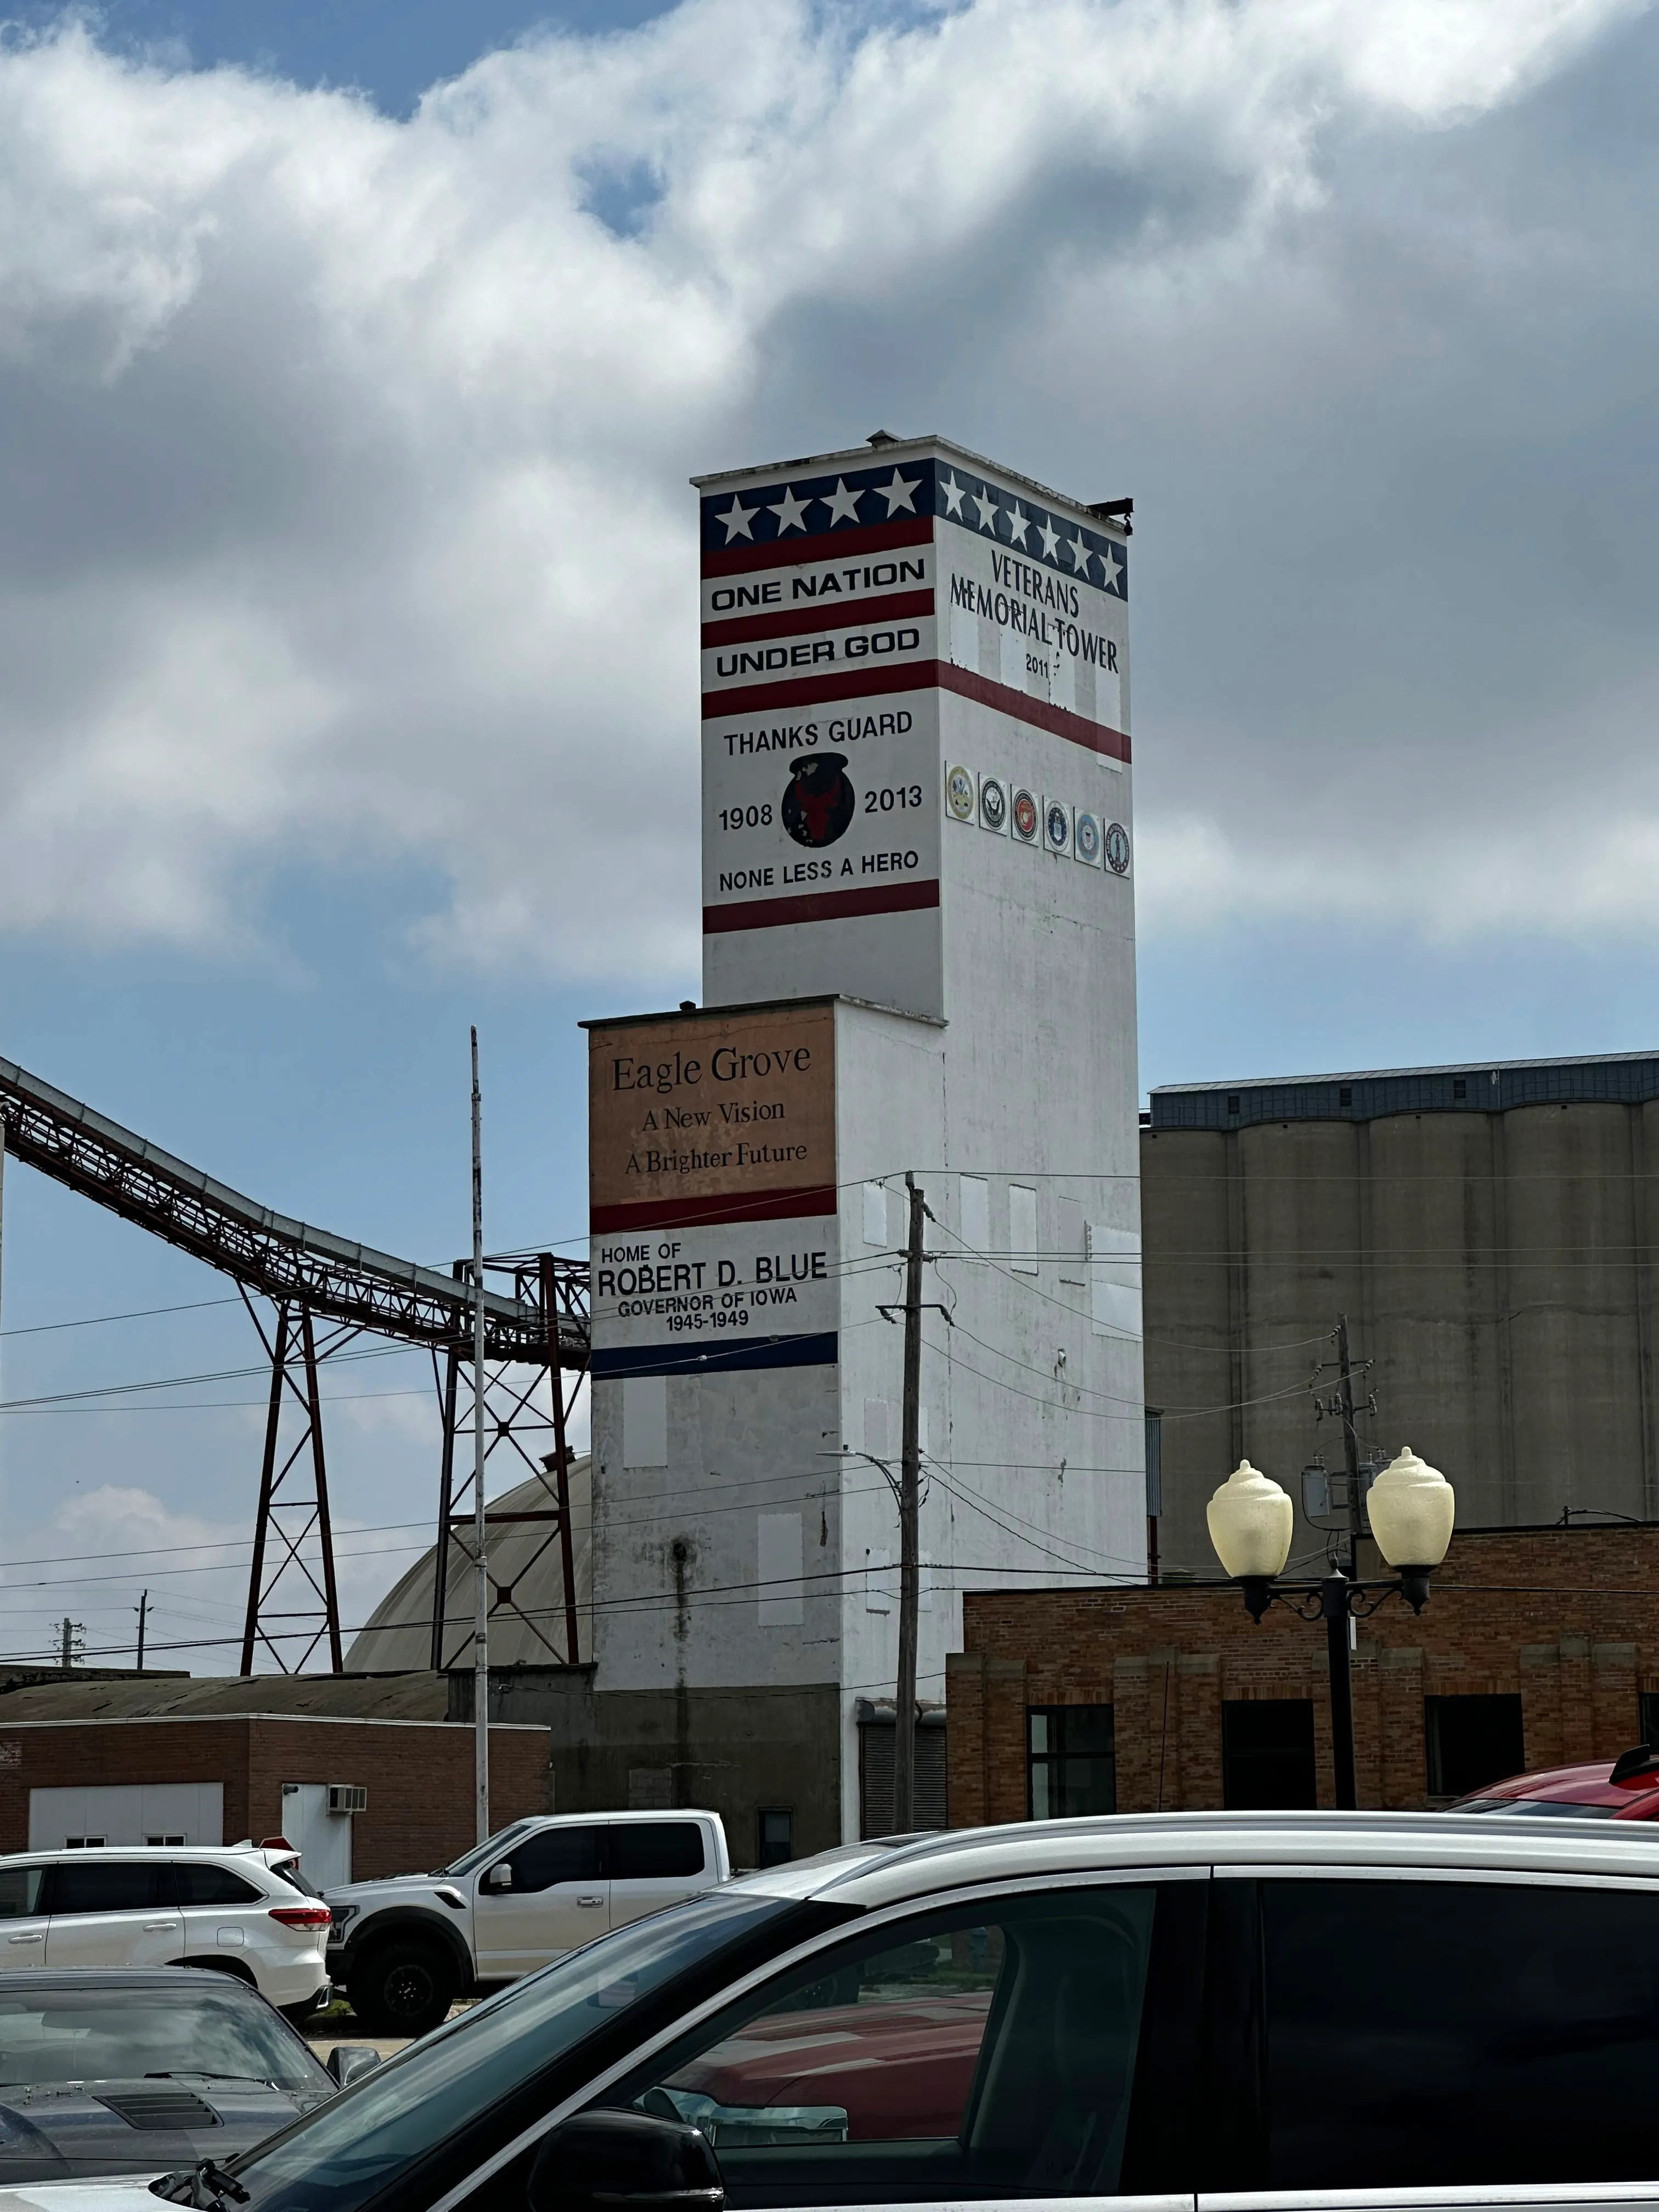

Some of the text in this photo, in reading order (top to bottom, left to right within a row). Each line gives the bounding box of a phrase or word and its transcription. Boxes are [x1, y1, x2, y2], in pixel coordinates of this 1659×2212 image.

[712, 558, 925, 611] ONE NATION
[991, 549, 1079, 618] VETERANS
[950, 573, 1119, 674] MEMORIAL TOWER
[716, 628, 919, 677] UNDER GOD
[724, 710, 912, 755] THANKS GUARD
[719, 804, 772, 831] 1908
[865, 785, 922, 813] 2013
[720, 850, 919, 891] NONE LESS A HERO
[612, 1047, 811, 1094] Eagle Grove
[641, 1100, 786, 1132] A New Vision
[624, 1142, 808, 1174] A Brighter Future
[602, 1242, 681, 1263] HOME OF
[598, 1251, 827, 1297] ROBERT D. BLUE
[618, 1287, 798, 1317] GOVERNOR OF IOWA
[666, 1310, 749, 1331] 1945-1949
